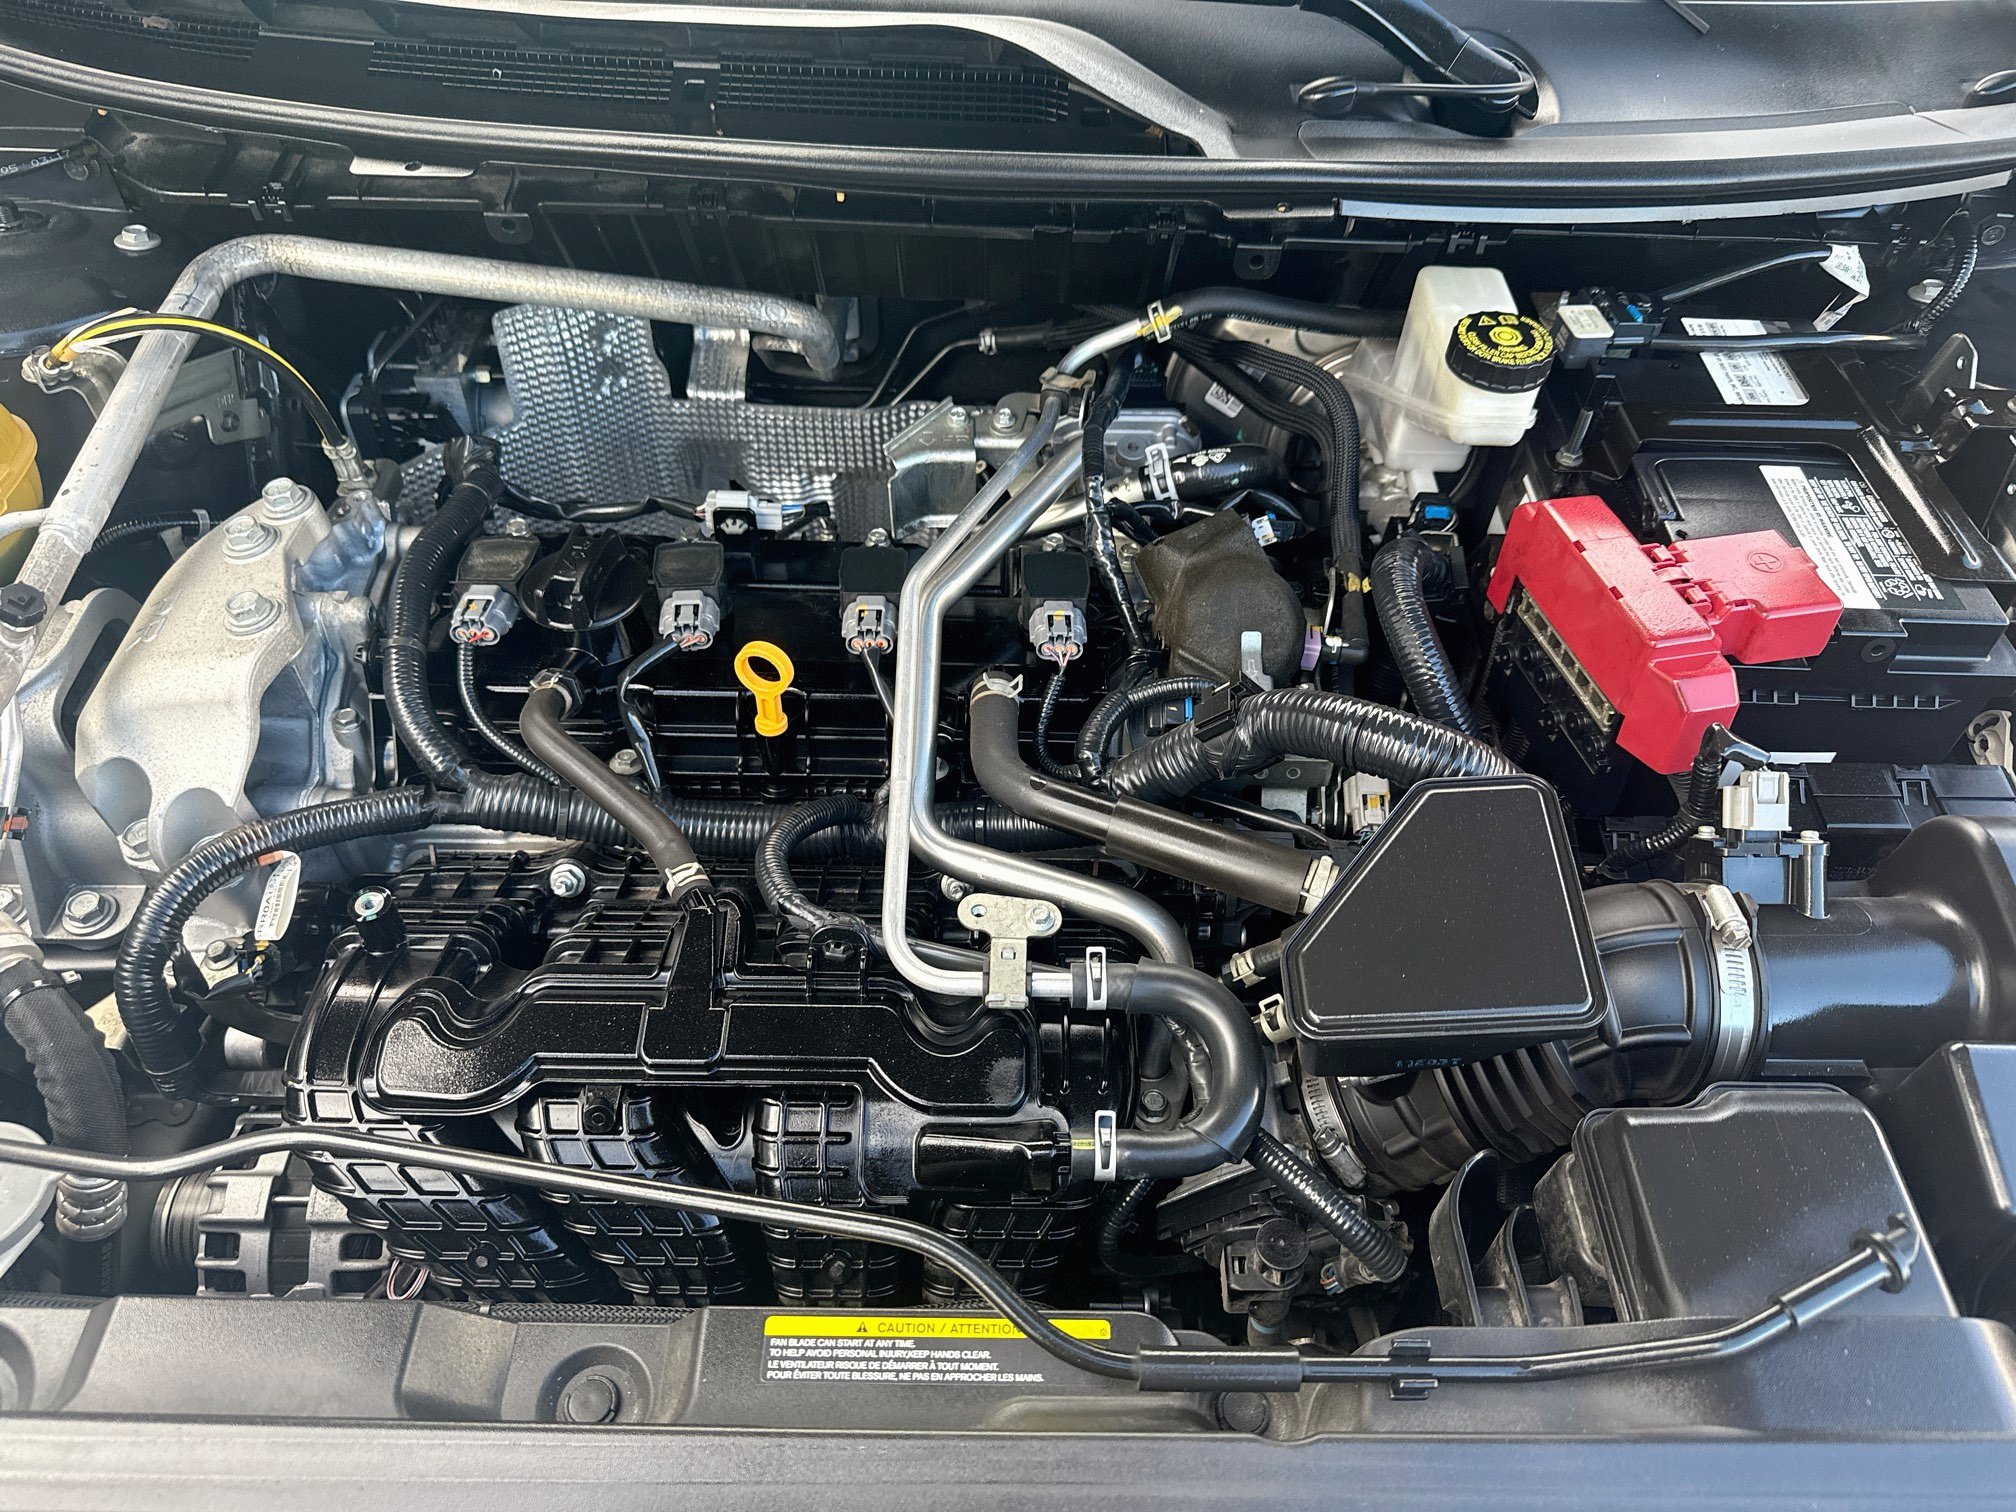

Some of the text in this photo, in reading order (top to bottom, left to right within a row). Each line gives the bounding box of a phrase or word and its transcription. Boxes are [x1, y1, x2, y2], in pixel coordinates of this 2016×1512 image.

[878, 1323, 935, 1333] CAUTION
[770, 1338, 787, 1346] FAN
[837, 1339, 863, 1347] START
[864, 1339, 875, 1347] AT
[895, 1340, 916, 1348] TIME.
[769, 1348, 781, 1356] TO
[805, 1349, 832, 1357] AVOID
[833, 1349, 878, 1357] PERSONAL
[930, 1350, 961, 1358] HANDS
[961, 1351, 991, 1359] CLEAR.
[768, 1360, 780, 1368] LE
[780, 1360, 835, 1369] VENTILATEUR
[835, 1361, 868, 1369] RISQUE
[868, 1361, 881, 1369] DE
[882, 1359, 928, 1370] DÉMARRER
[937, 1362, 959, 1370] TOUT
[767, 1371, 793, 1379] POUR
[793, 1369, 823, 1379] ÉVITER
[823, 1371, 851, 1379] TOUTE
[851, 1372, 898, 1381] BLESSURE,
[899, 1372, 912, 1380] NE
[912, 1372, 930, 1380] PAS
[943, 1373, 998, 1381] APPROCHER
[998, 1373, 1014, 1381] LES
[1015, 1374, 1045, 1382] MAINS.
